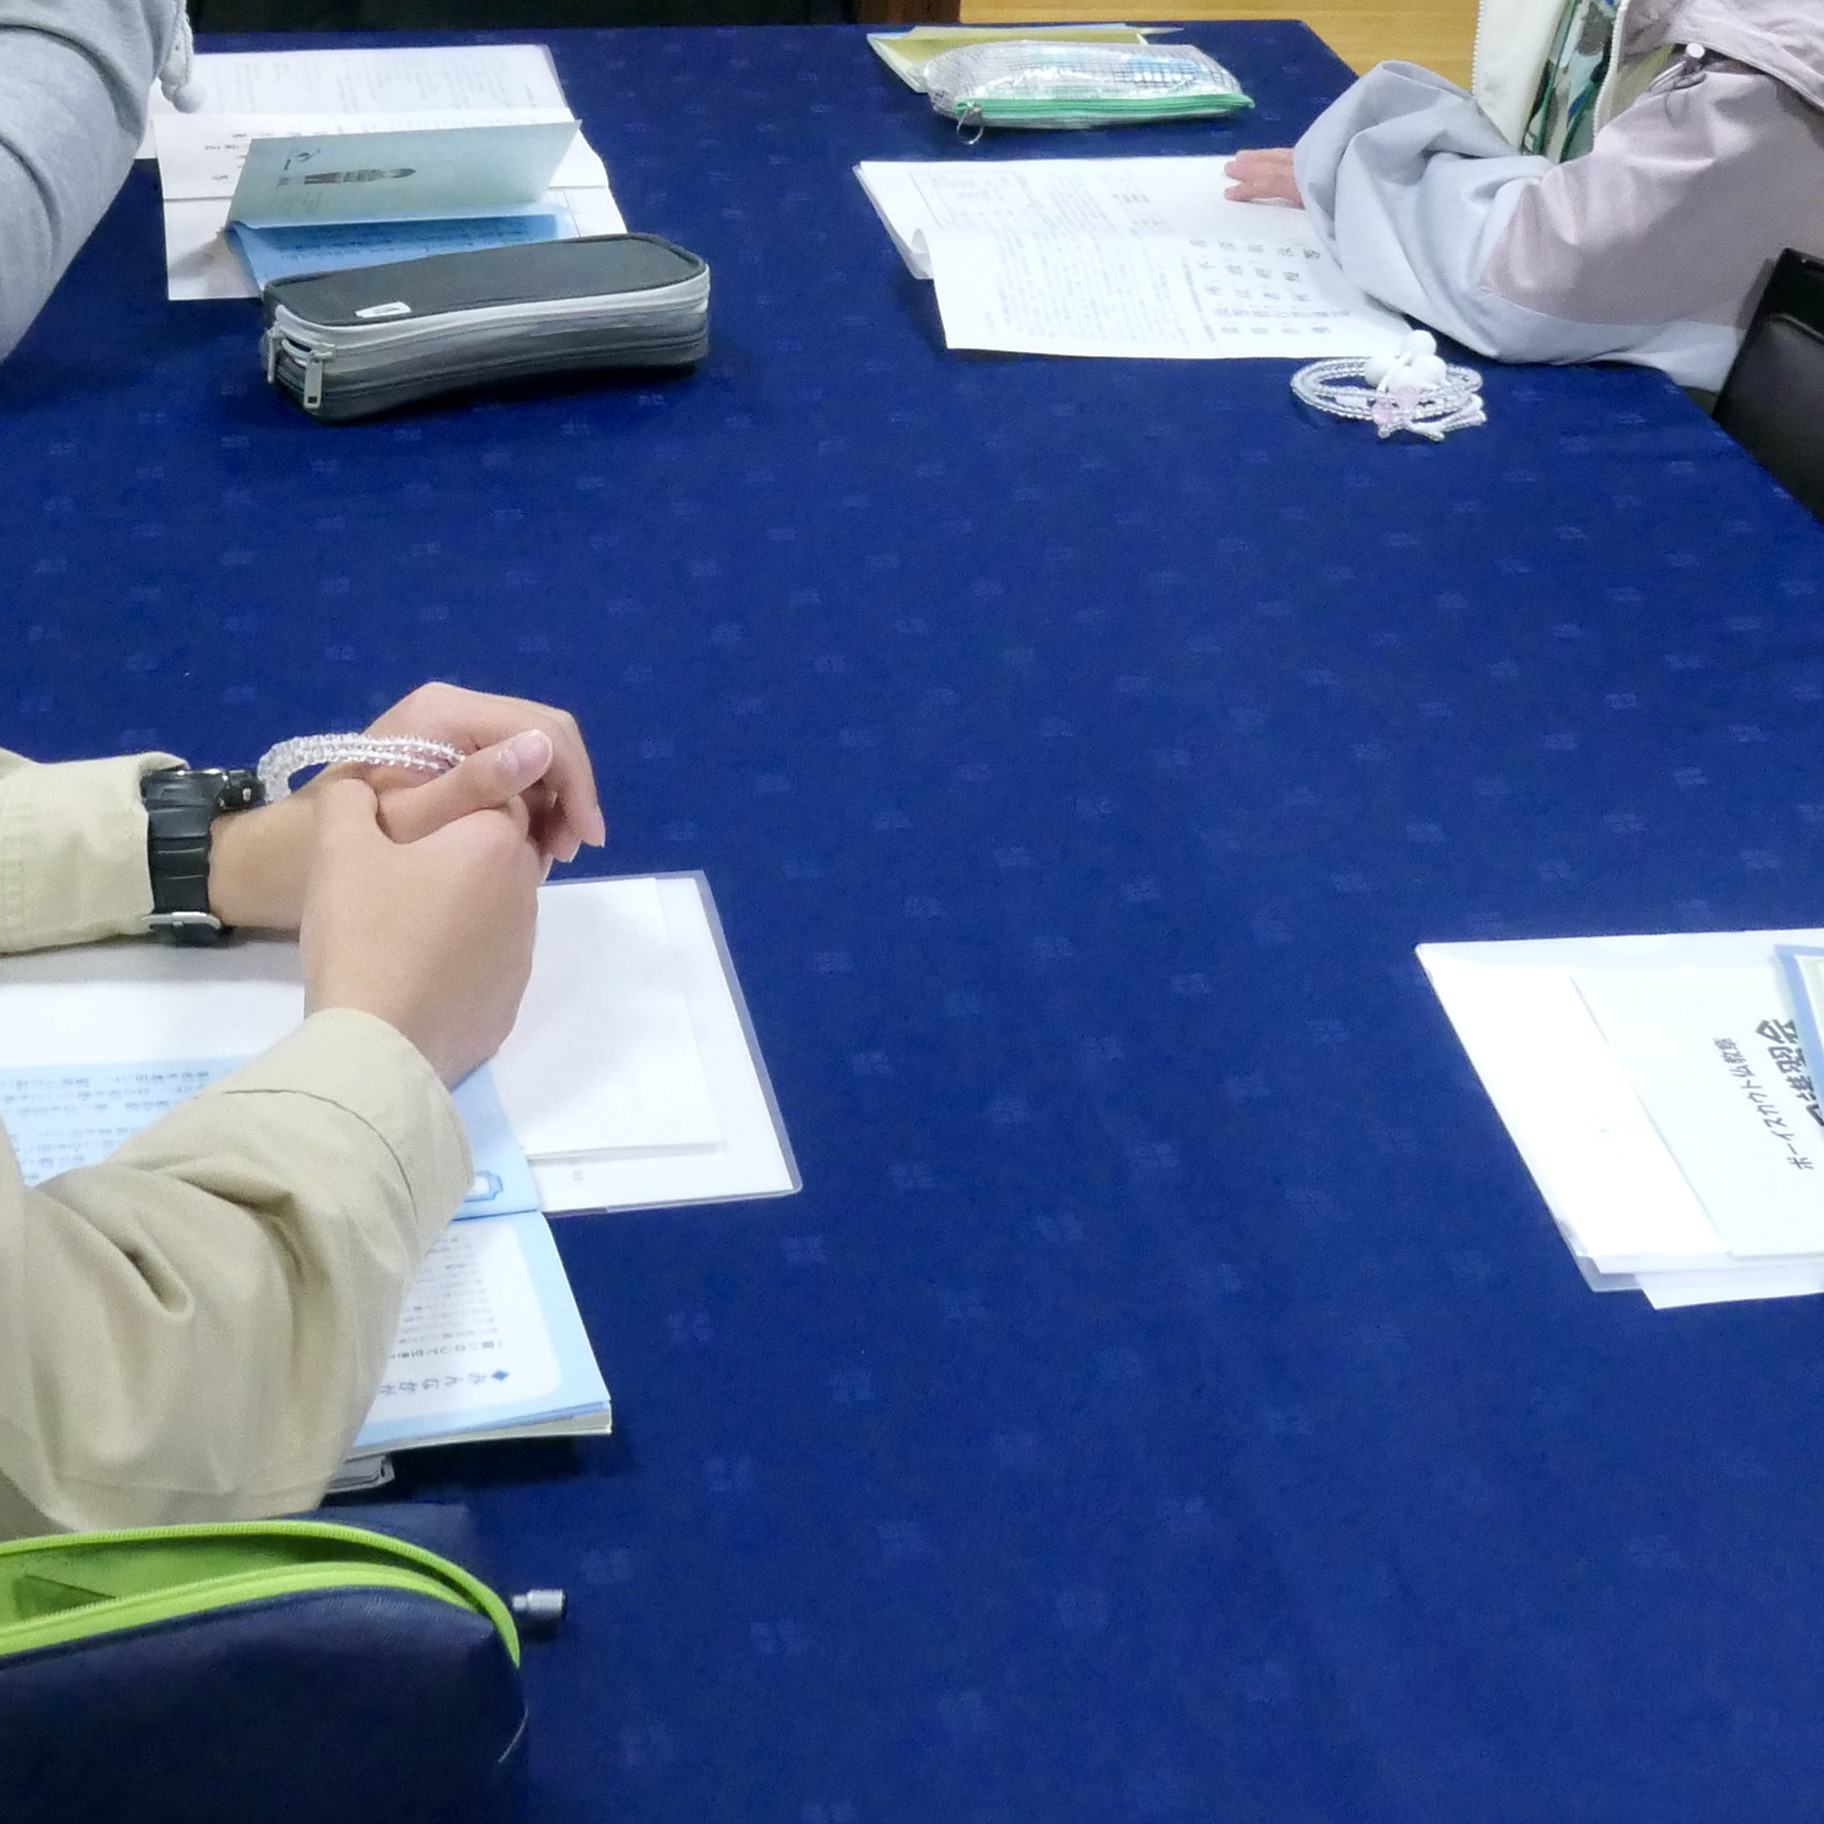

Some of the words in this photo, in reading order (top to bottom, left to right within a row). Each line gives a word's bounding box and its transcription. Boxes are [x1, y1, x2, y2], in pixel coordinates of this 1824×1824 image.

[1712, 1036, 1814, 1171] ボーイスカウト仏教章
